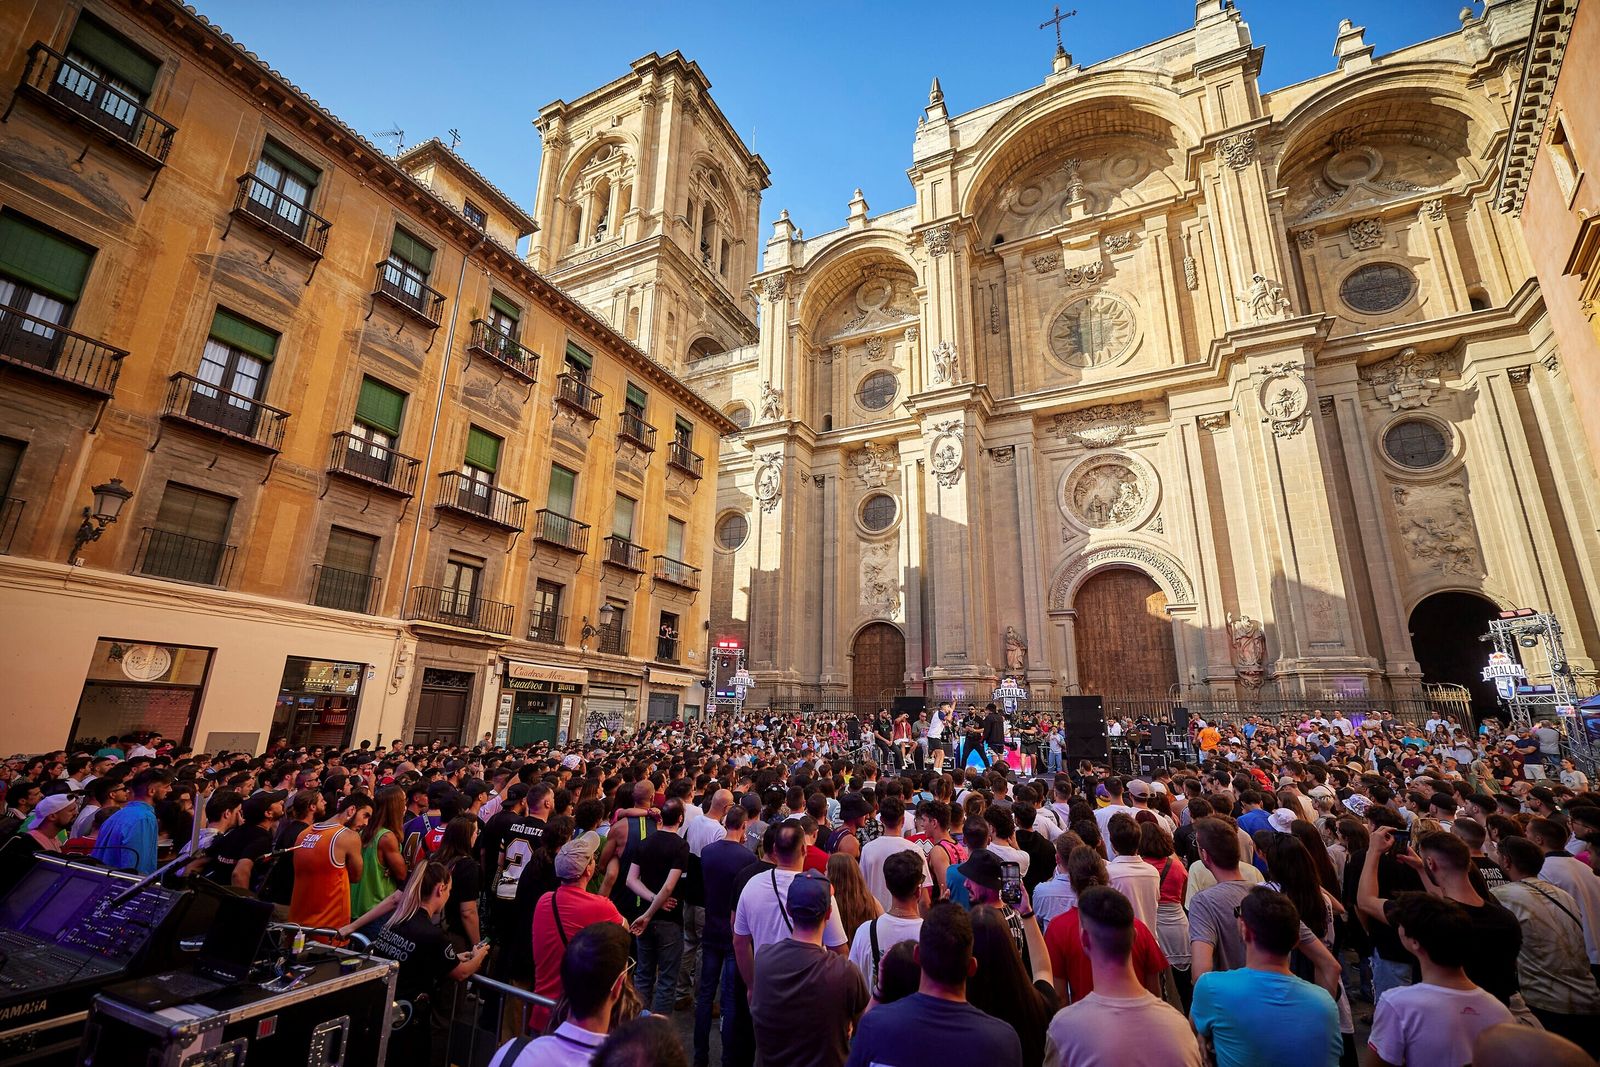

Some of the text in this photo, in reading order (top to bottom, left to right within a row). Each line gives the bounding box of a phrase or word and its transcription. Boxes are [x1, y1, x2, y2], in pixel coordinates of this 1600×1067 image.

[1485, 665, 1521, 677] BATALLA
[508, 678, 543, 690] Cuadros
[997, 689, 1023, 697] BATALLA
[1480, 868, 1503, 879] PARIS
[378, 926, 416, 952] EGURIDAD
